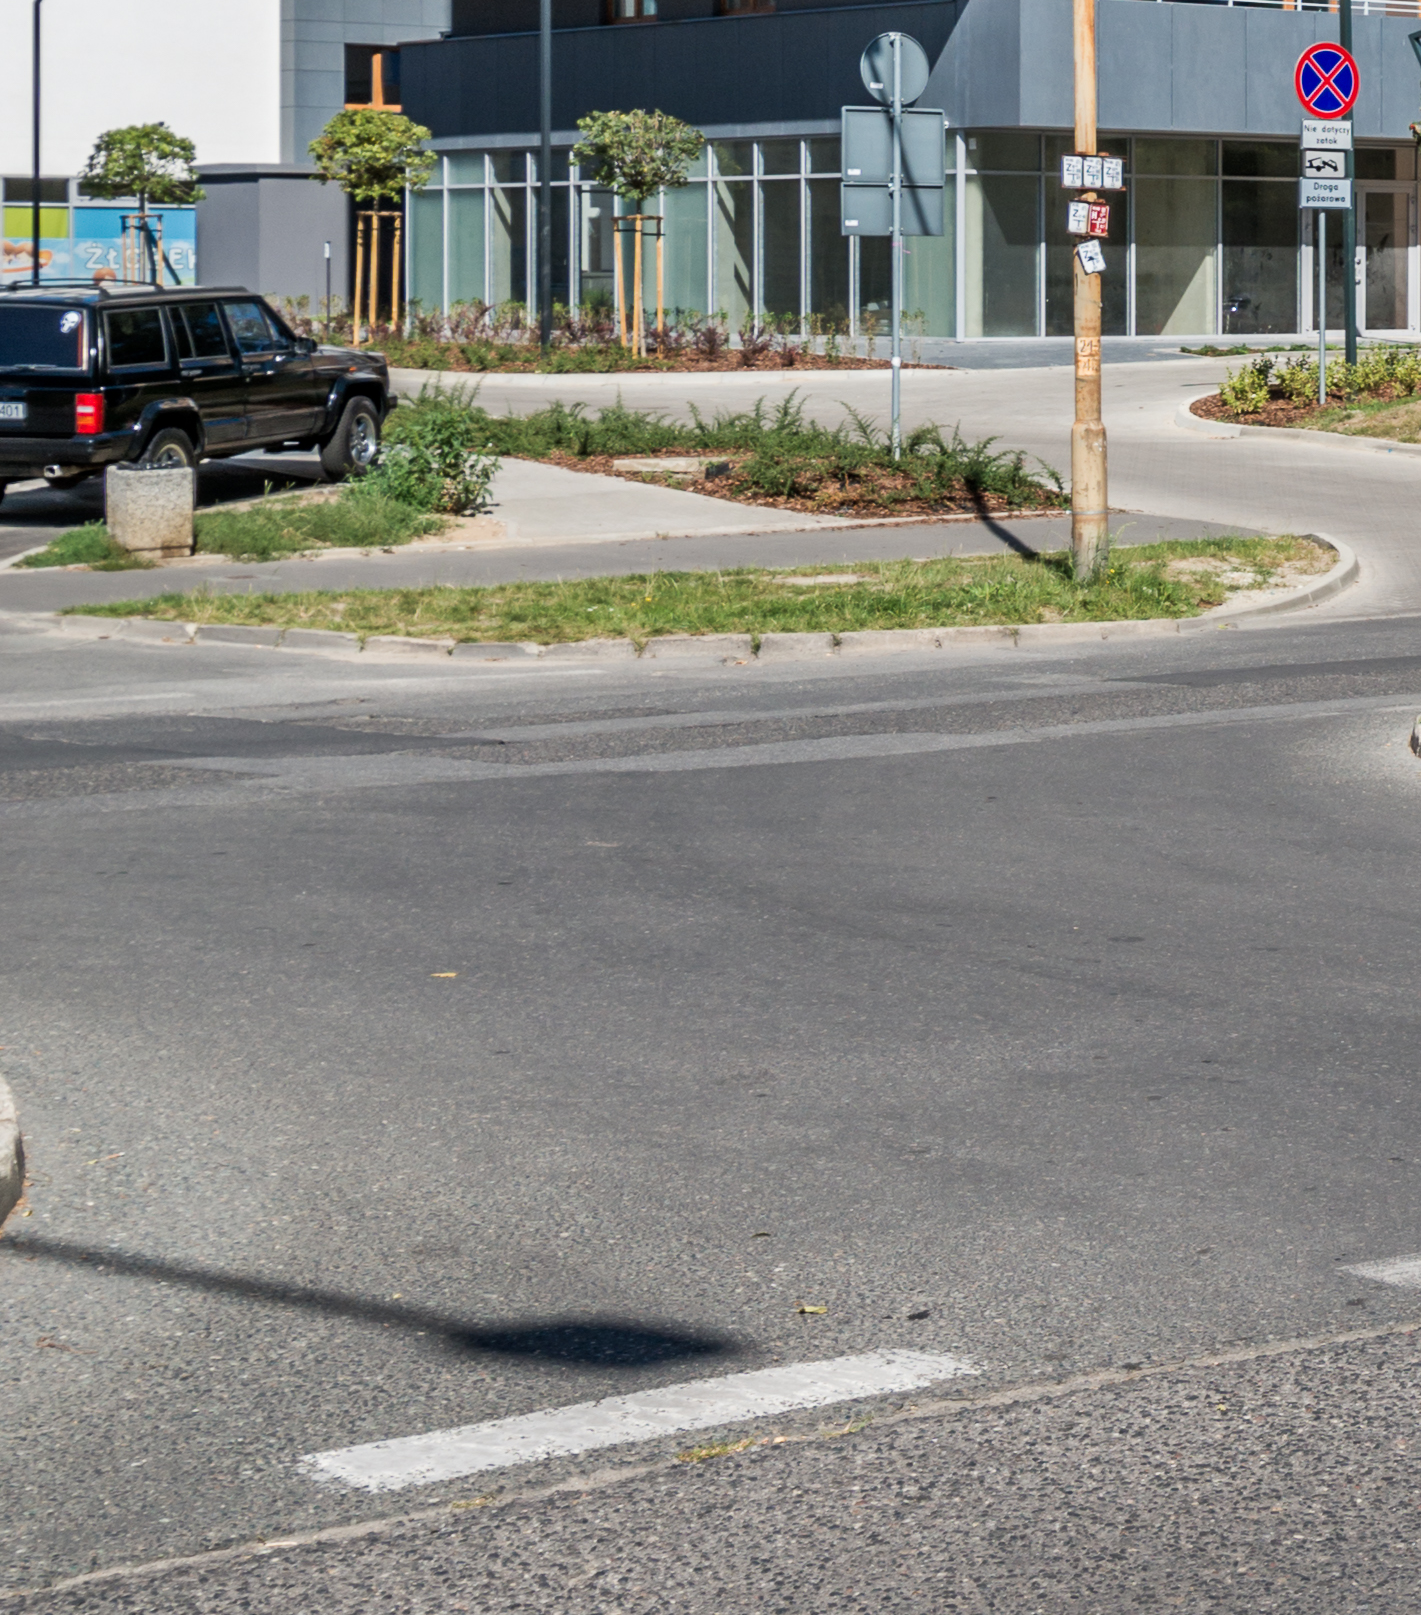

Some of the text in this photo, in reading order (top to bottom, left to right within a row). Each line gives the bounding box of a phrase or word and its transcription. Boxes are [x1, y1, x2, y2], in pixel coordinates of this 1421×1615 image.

[1304, 124, 1350, 136] Nie dotyczy
[1316, 137, 1338, 145] zatok
[1313, 182, 1339, 193] Droga
[1306, 194, 1346, 204] pożarowa
